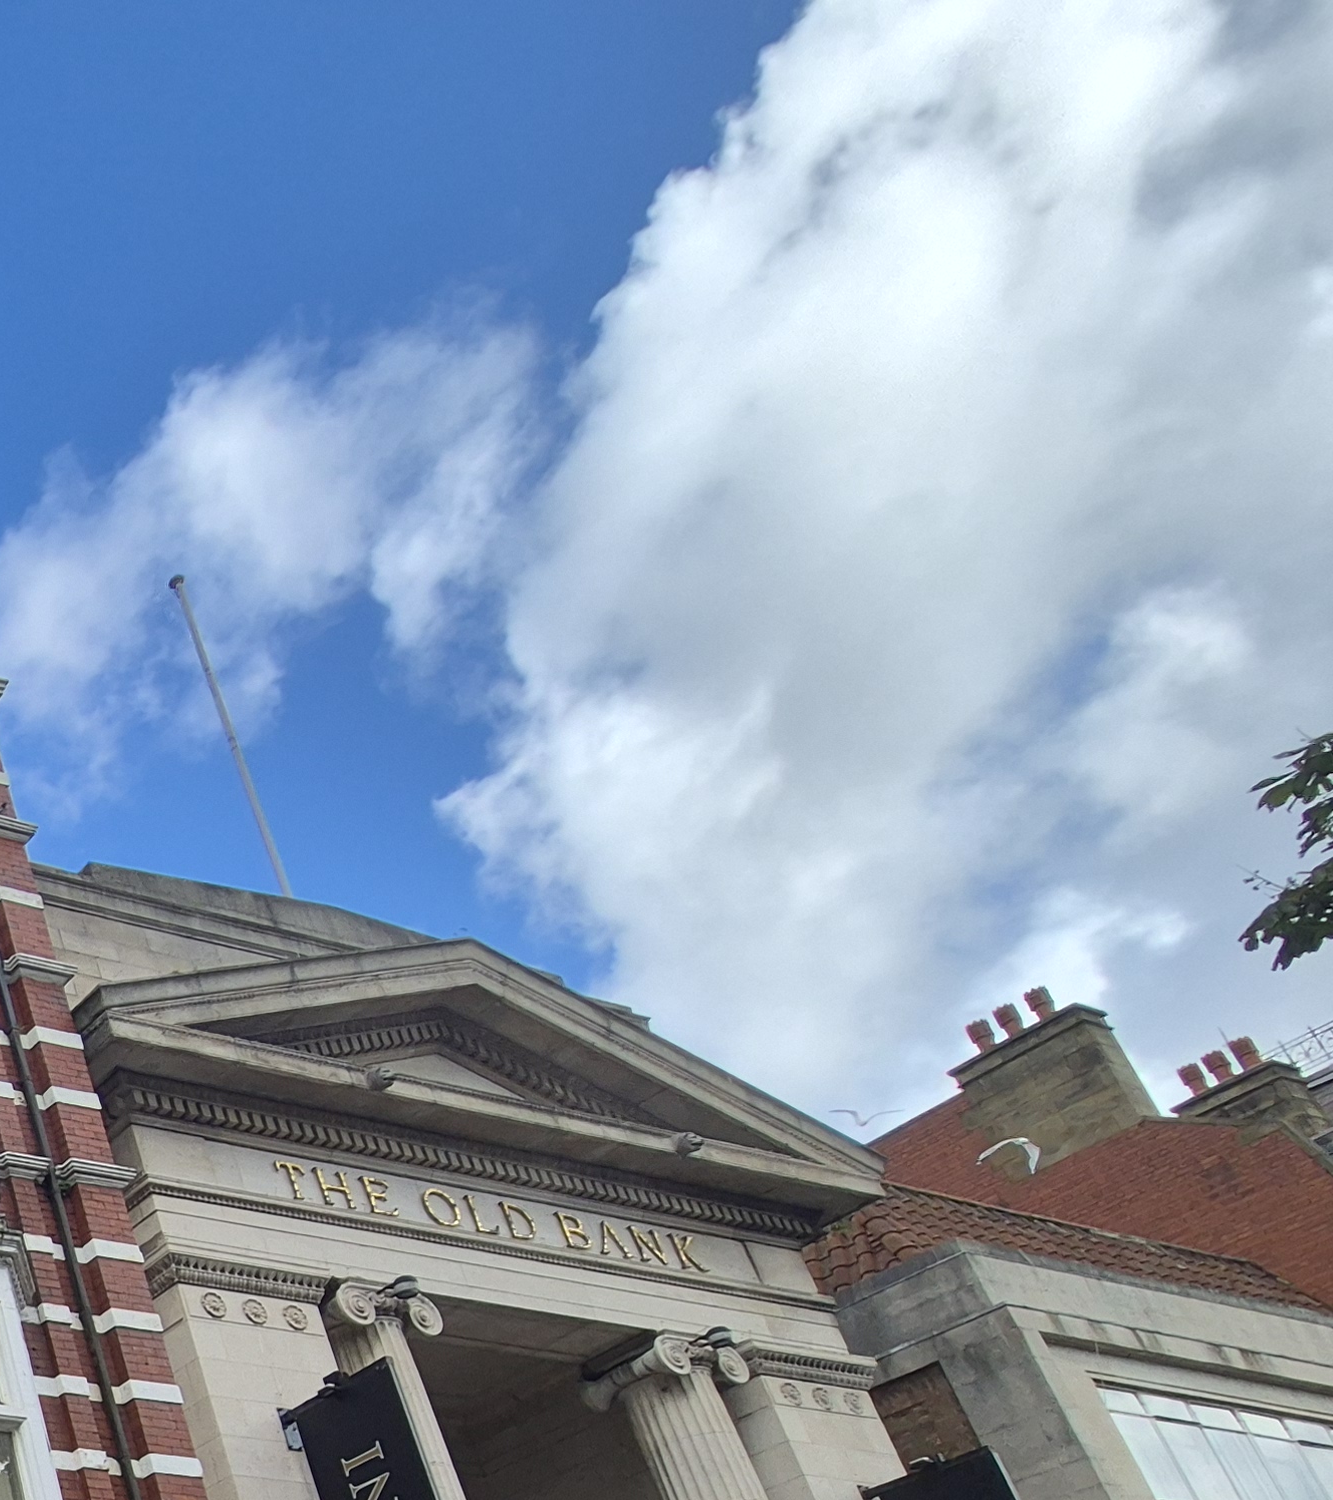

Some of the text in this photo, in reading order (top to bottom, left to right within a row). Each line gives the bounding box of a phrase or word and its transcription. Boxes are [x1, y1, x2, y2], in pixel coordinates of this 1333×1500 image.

[273, 1160, 711, 1274] THE OLD BANK
